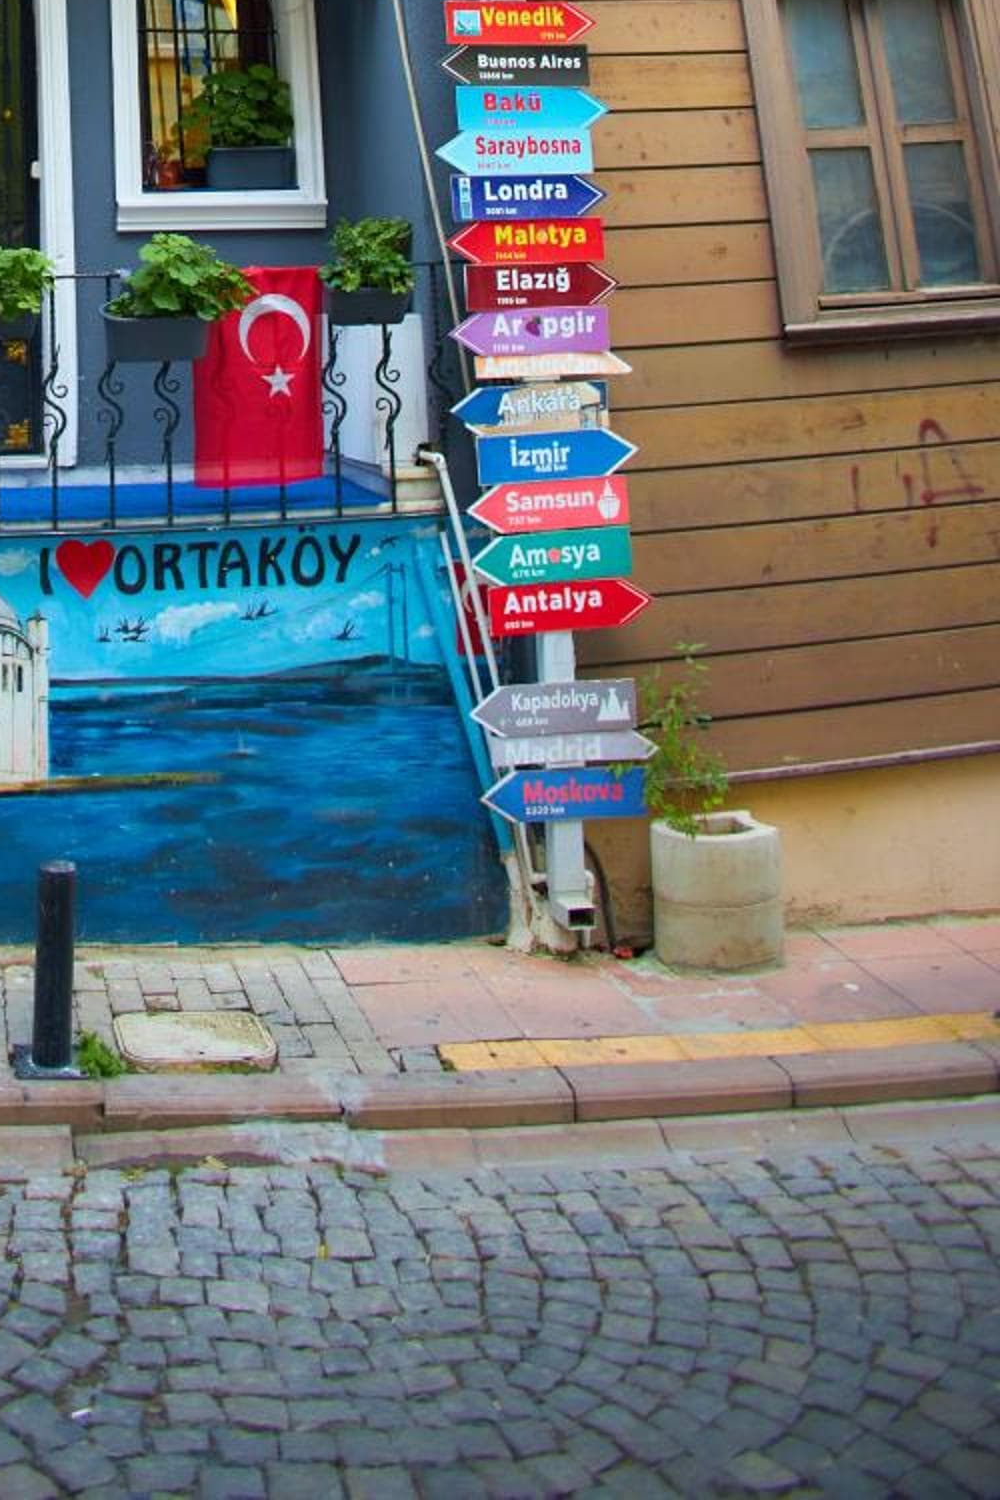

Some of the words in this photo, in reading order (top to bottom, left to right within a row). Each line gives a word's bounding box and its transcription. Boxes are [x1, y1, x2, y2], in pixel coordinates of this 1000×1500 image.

[481, 6, 565, 27] Venedik
[477, 53, 537, 69] Buenos
[540, 54, 582, 69] Aires
[475, 135, 581, 161] Saraybosna
[484, 179, 568, 201] Londra
[496, 267, 571, 293] Elazığ
[492, 310, 596, 339] Arpgir
[497, 389, 581, 416] Ankara
[510, 438, 570, 467] İzmir
[505, 491, 594, 513] Samsun
[113, 524, 362, 595] ORTAKÖY
[509, 543, 601, 569] Amsya
[503, 586, 603, 615] Antalya
[511, 687, 599, 714] Kapadokya
[505, 734, 602, 762] Madrid
[523, 778, 624, 805] Moskova
